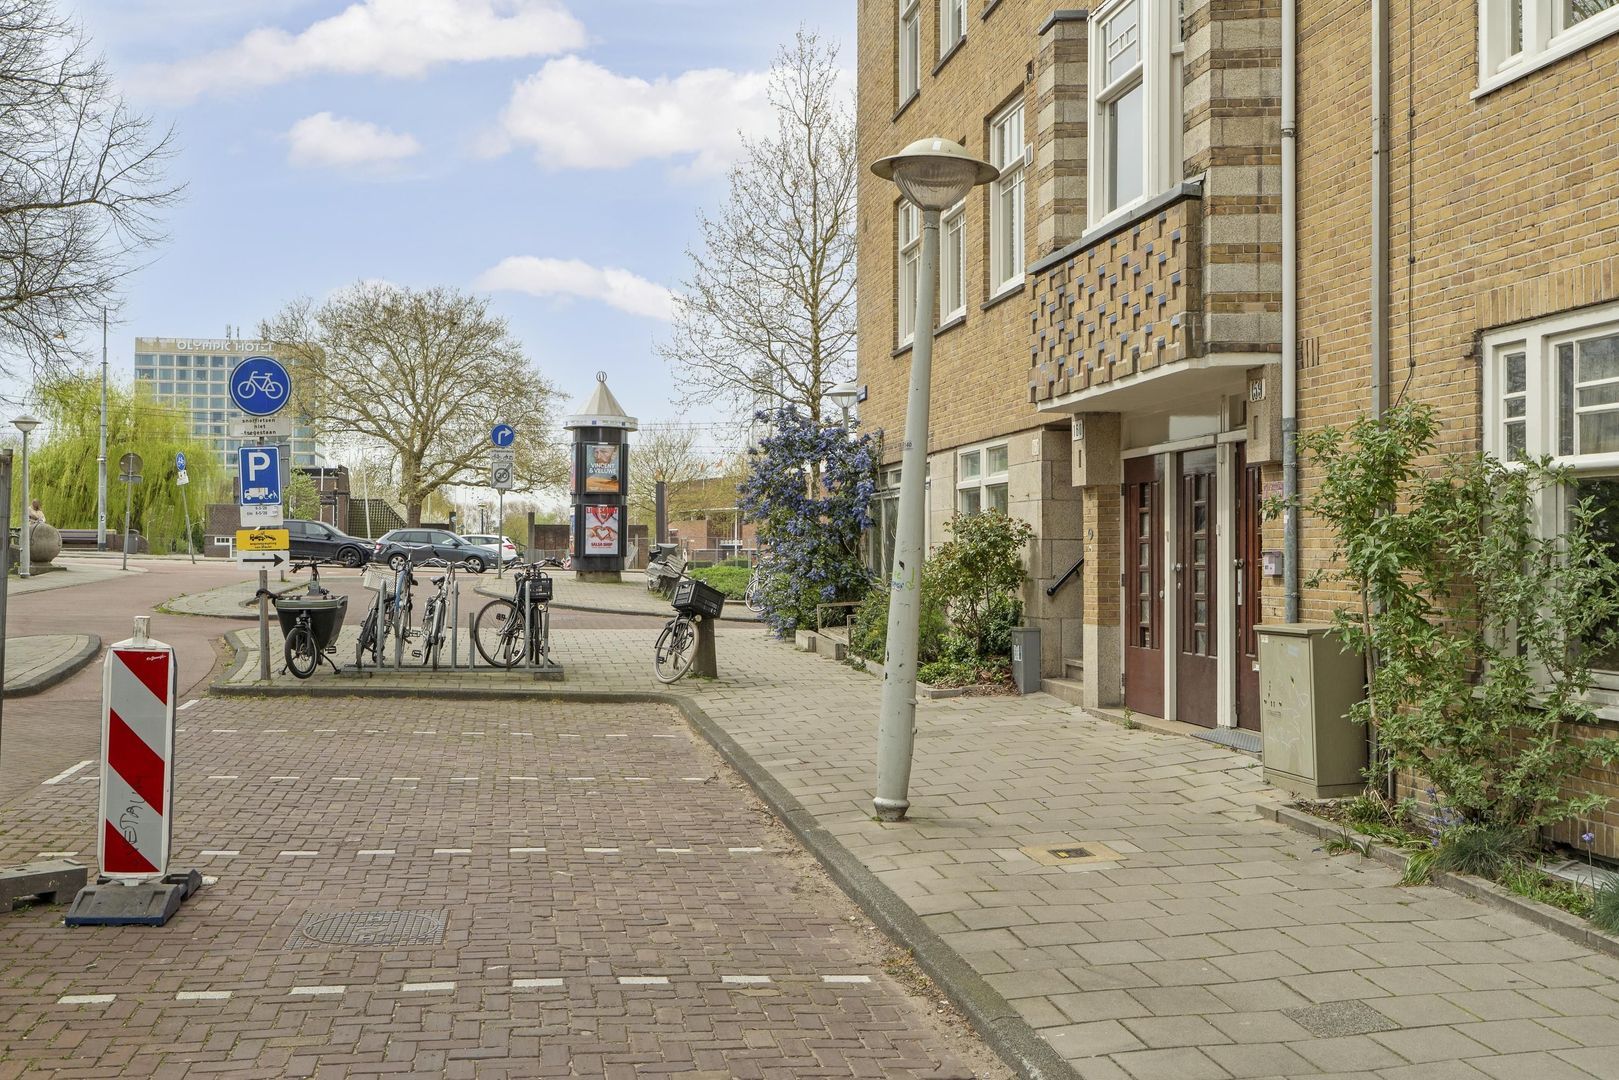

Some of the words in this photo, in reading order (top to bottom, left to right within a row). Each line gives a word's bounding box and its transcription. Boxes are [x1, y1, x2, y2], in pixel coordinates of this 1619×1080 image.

[177, 341, 231, 351] OLYMPIC
[235, 342, 274, 352] HOTEL
[1251, 380, 1263, 400] 159
[248, 452, 271, 482] P
